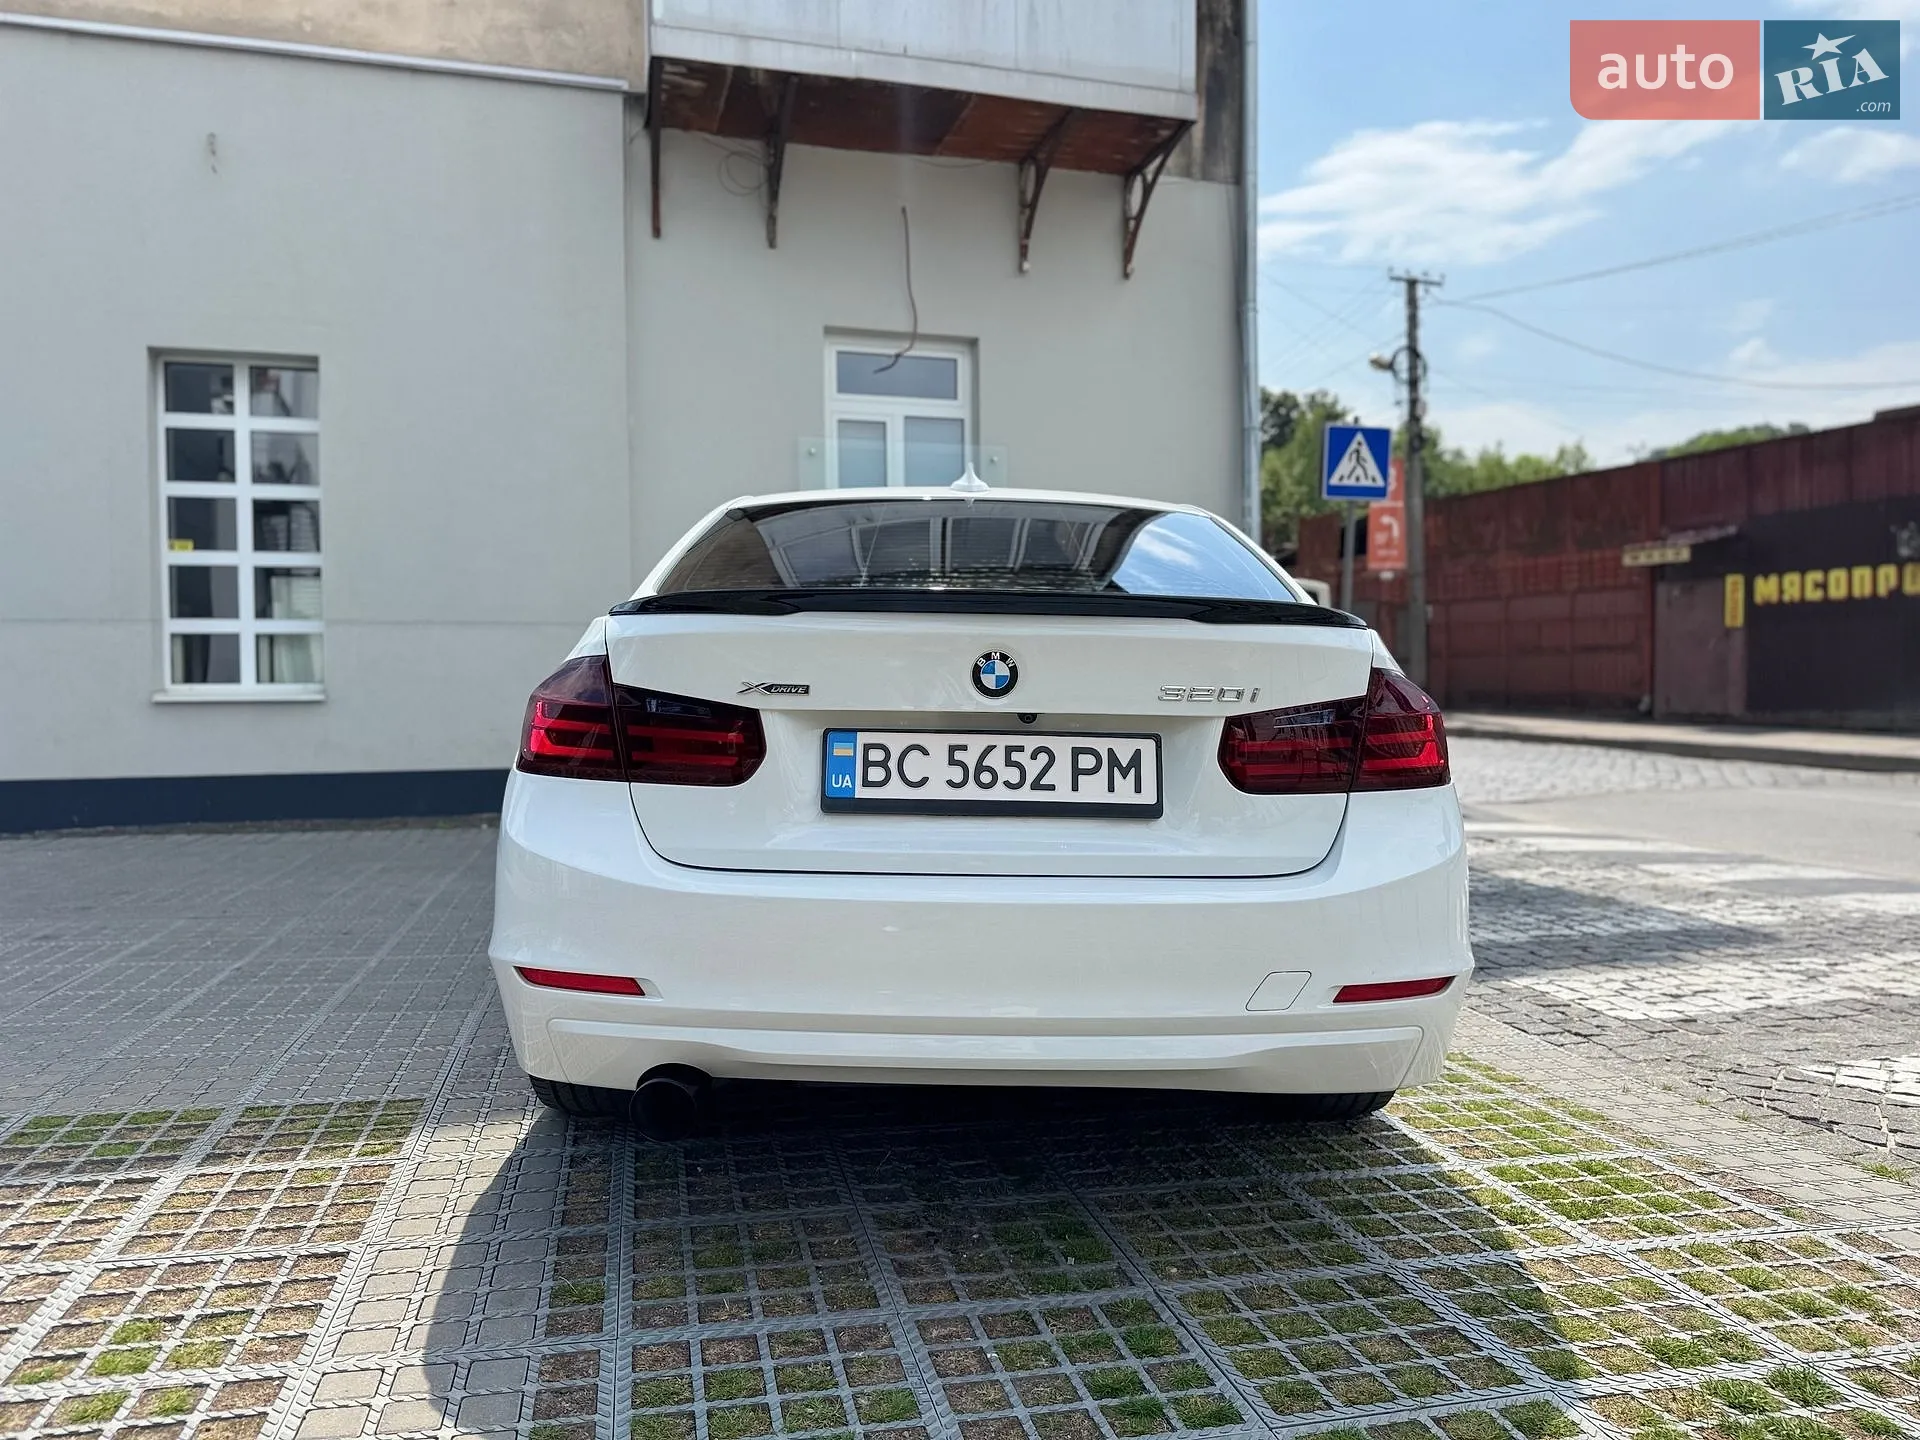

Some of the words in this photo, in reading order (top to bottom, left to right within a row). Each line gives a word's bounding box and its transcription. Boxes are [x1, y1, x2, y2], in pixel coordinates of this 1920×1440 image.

[1158, 685, 1260, 703] 320i
[861, 743, 930, 789] BC
[945, 744, 1056, 792] 5652
[1071, 746, 1142, 794] PM
[832, 774, 852, 789] UA
